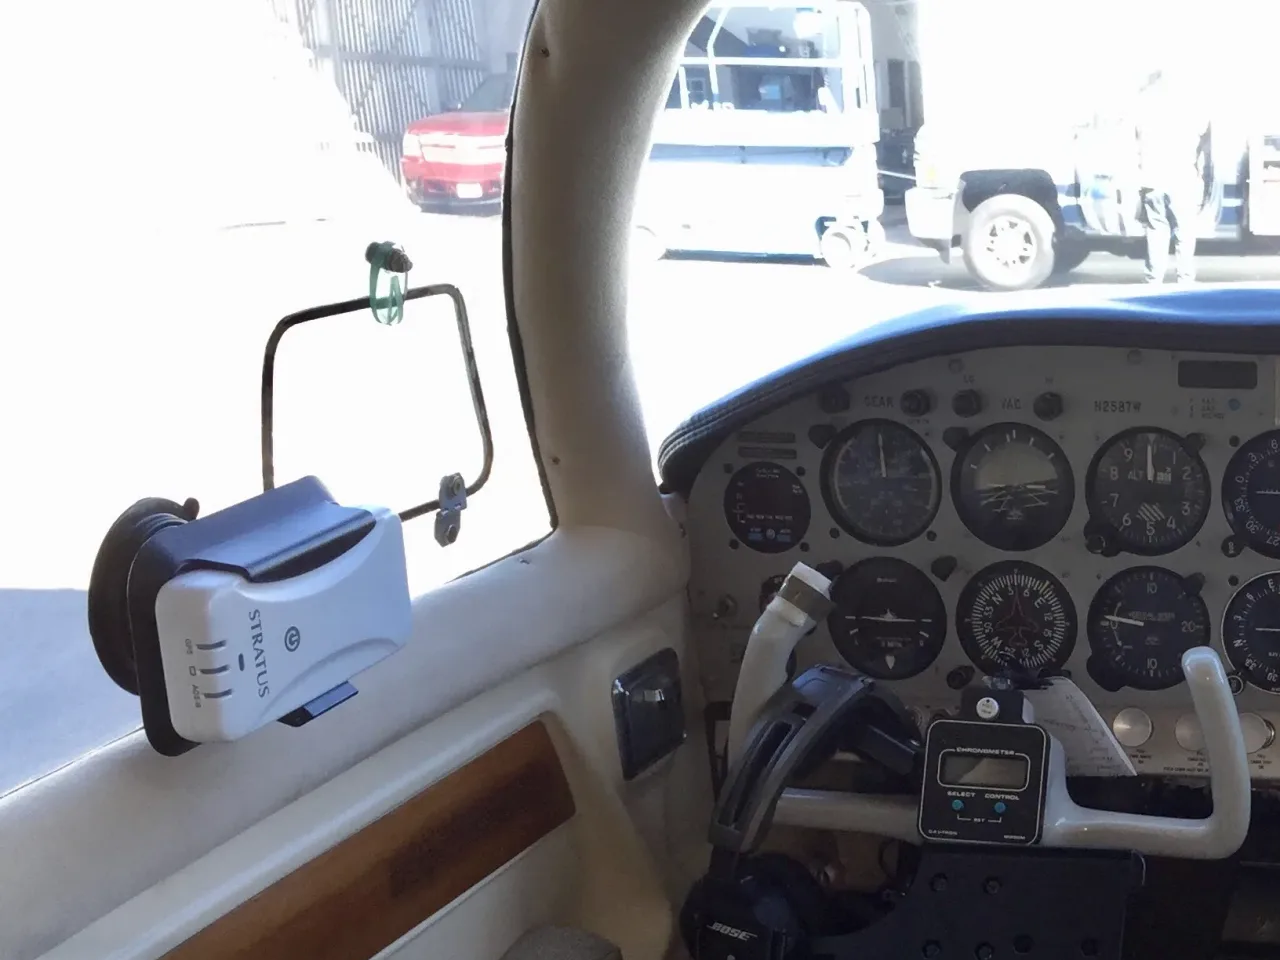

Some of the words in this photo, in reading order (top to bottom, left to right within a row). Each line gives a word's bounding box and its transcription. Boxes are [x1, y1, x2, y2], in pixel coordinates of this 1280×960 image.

[864, 395, 894, 408] GEAR
[1124, 448, 1133, 461] 9
[1110, 466, 1119, 480] 8
[1182, 466, 1192, 480] 2
[1110, 493, 1119, 507] 7
[1234, 498, 1245, 512] 33
[1181, 501, 1190, 516] 3
[1122, 513, 1132, 526] 6
[1166, 516, 1176, 529] 4
[1146, 522, 1155, 536] 5
[1266, 536, 1280, 547] 27
[1146, 582, 1158, 594] 10
[1267, 578, 1275, 589] E
[991, 592, 1004, 605] N
[1023, 588, 1030, 597] 6
[1034, 596, 1047, 608] E
[1181, 620, 1196, 633] 20
[1034, 640, 1044, 651] S
[249, 609, 270, 698] STRATUS
[1147, 658, 1158, 669] 10
[956, 746, 1015, 756] CHRONOMETER
[984, 793, 1020, 801] CONTROL
[706, 921, 758, 941] BOSE
